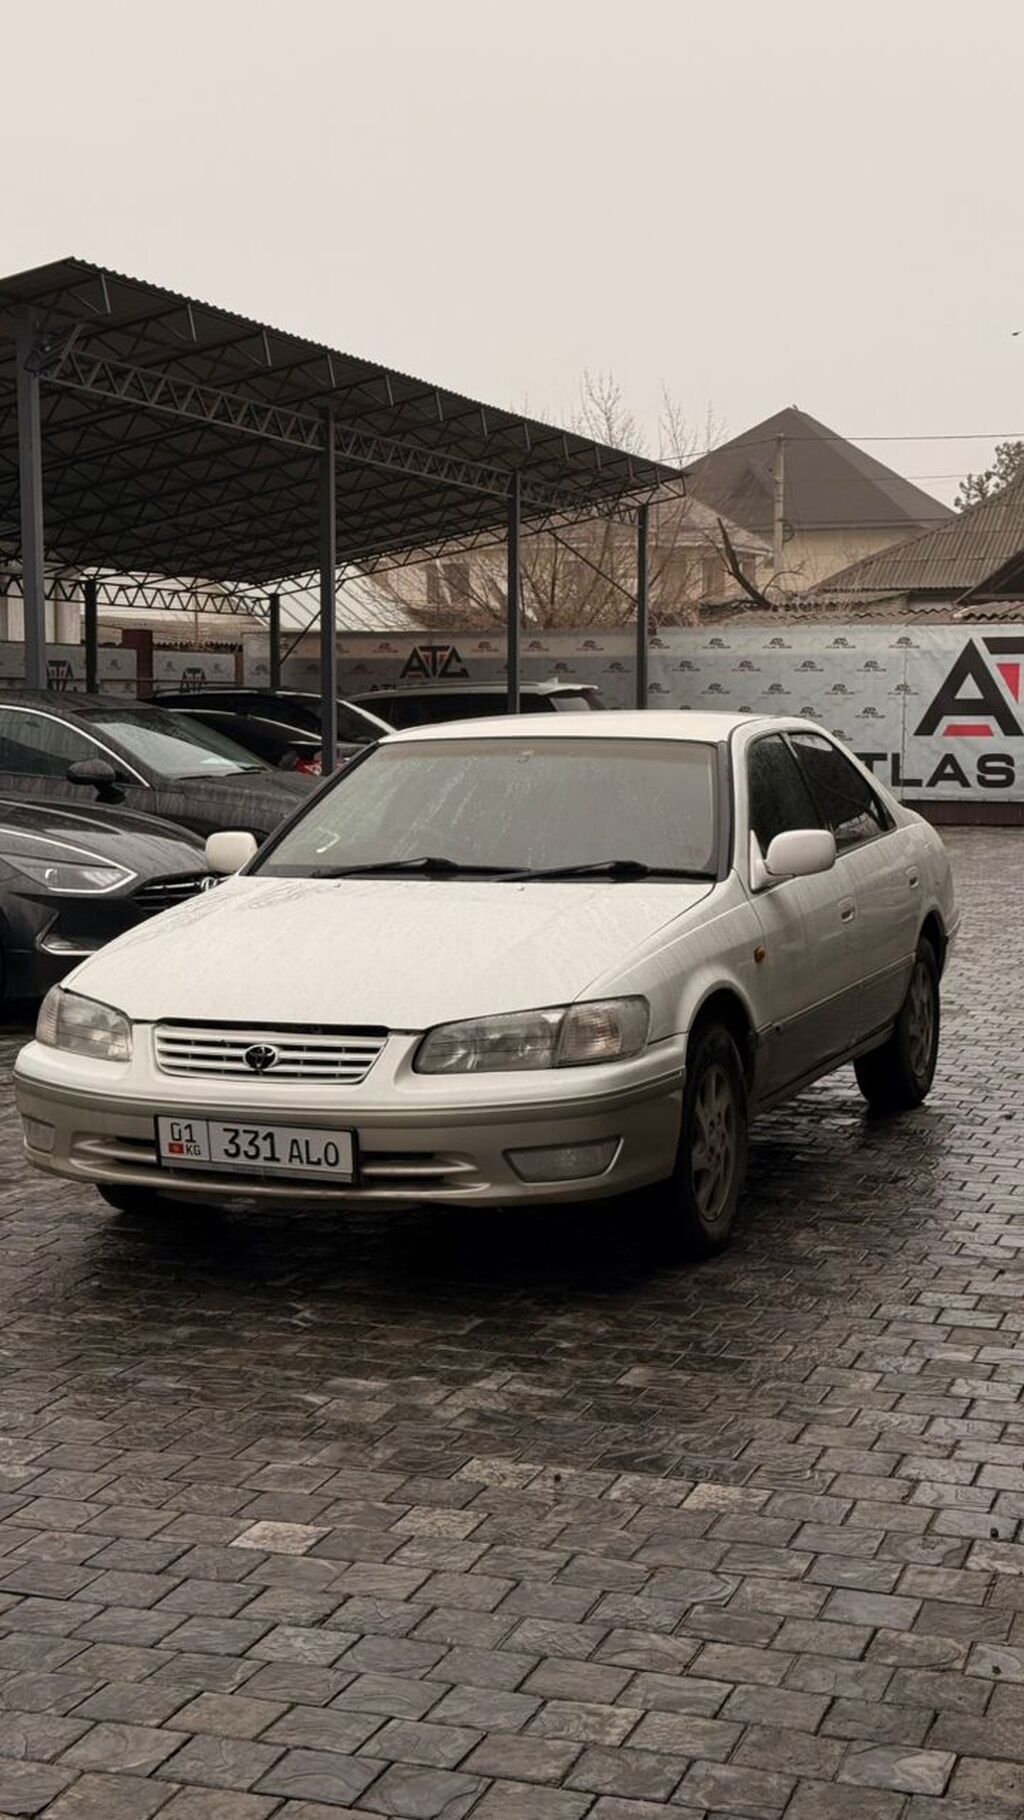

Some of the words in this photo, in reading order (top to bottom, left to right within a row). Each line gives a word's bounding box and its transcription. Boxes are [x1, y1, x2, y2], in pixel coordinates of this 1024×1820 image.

[853, 752, 1015, 788] TLAS
[170, 1121, 196, 1143] 01
[185, 1143, 202, 1156] KG
[222, 1127, 280, 1162] 331
[288, 1138, 340, 1167] ALO
